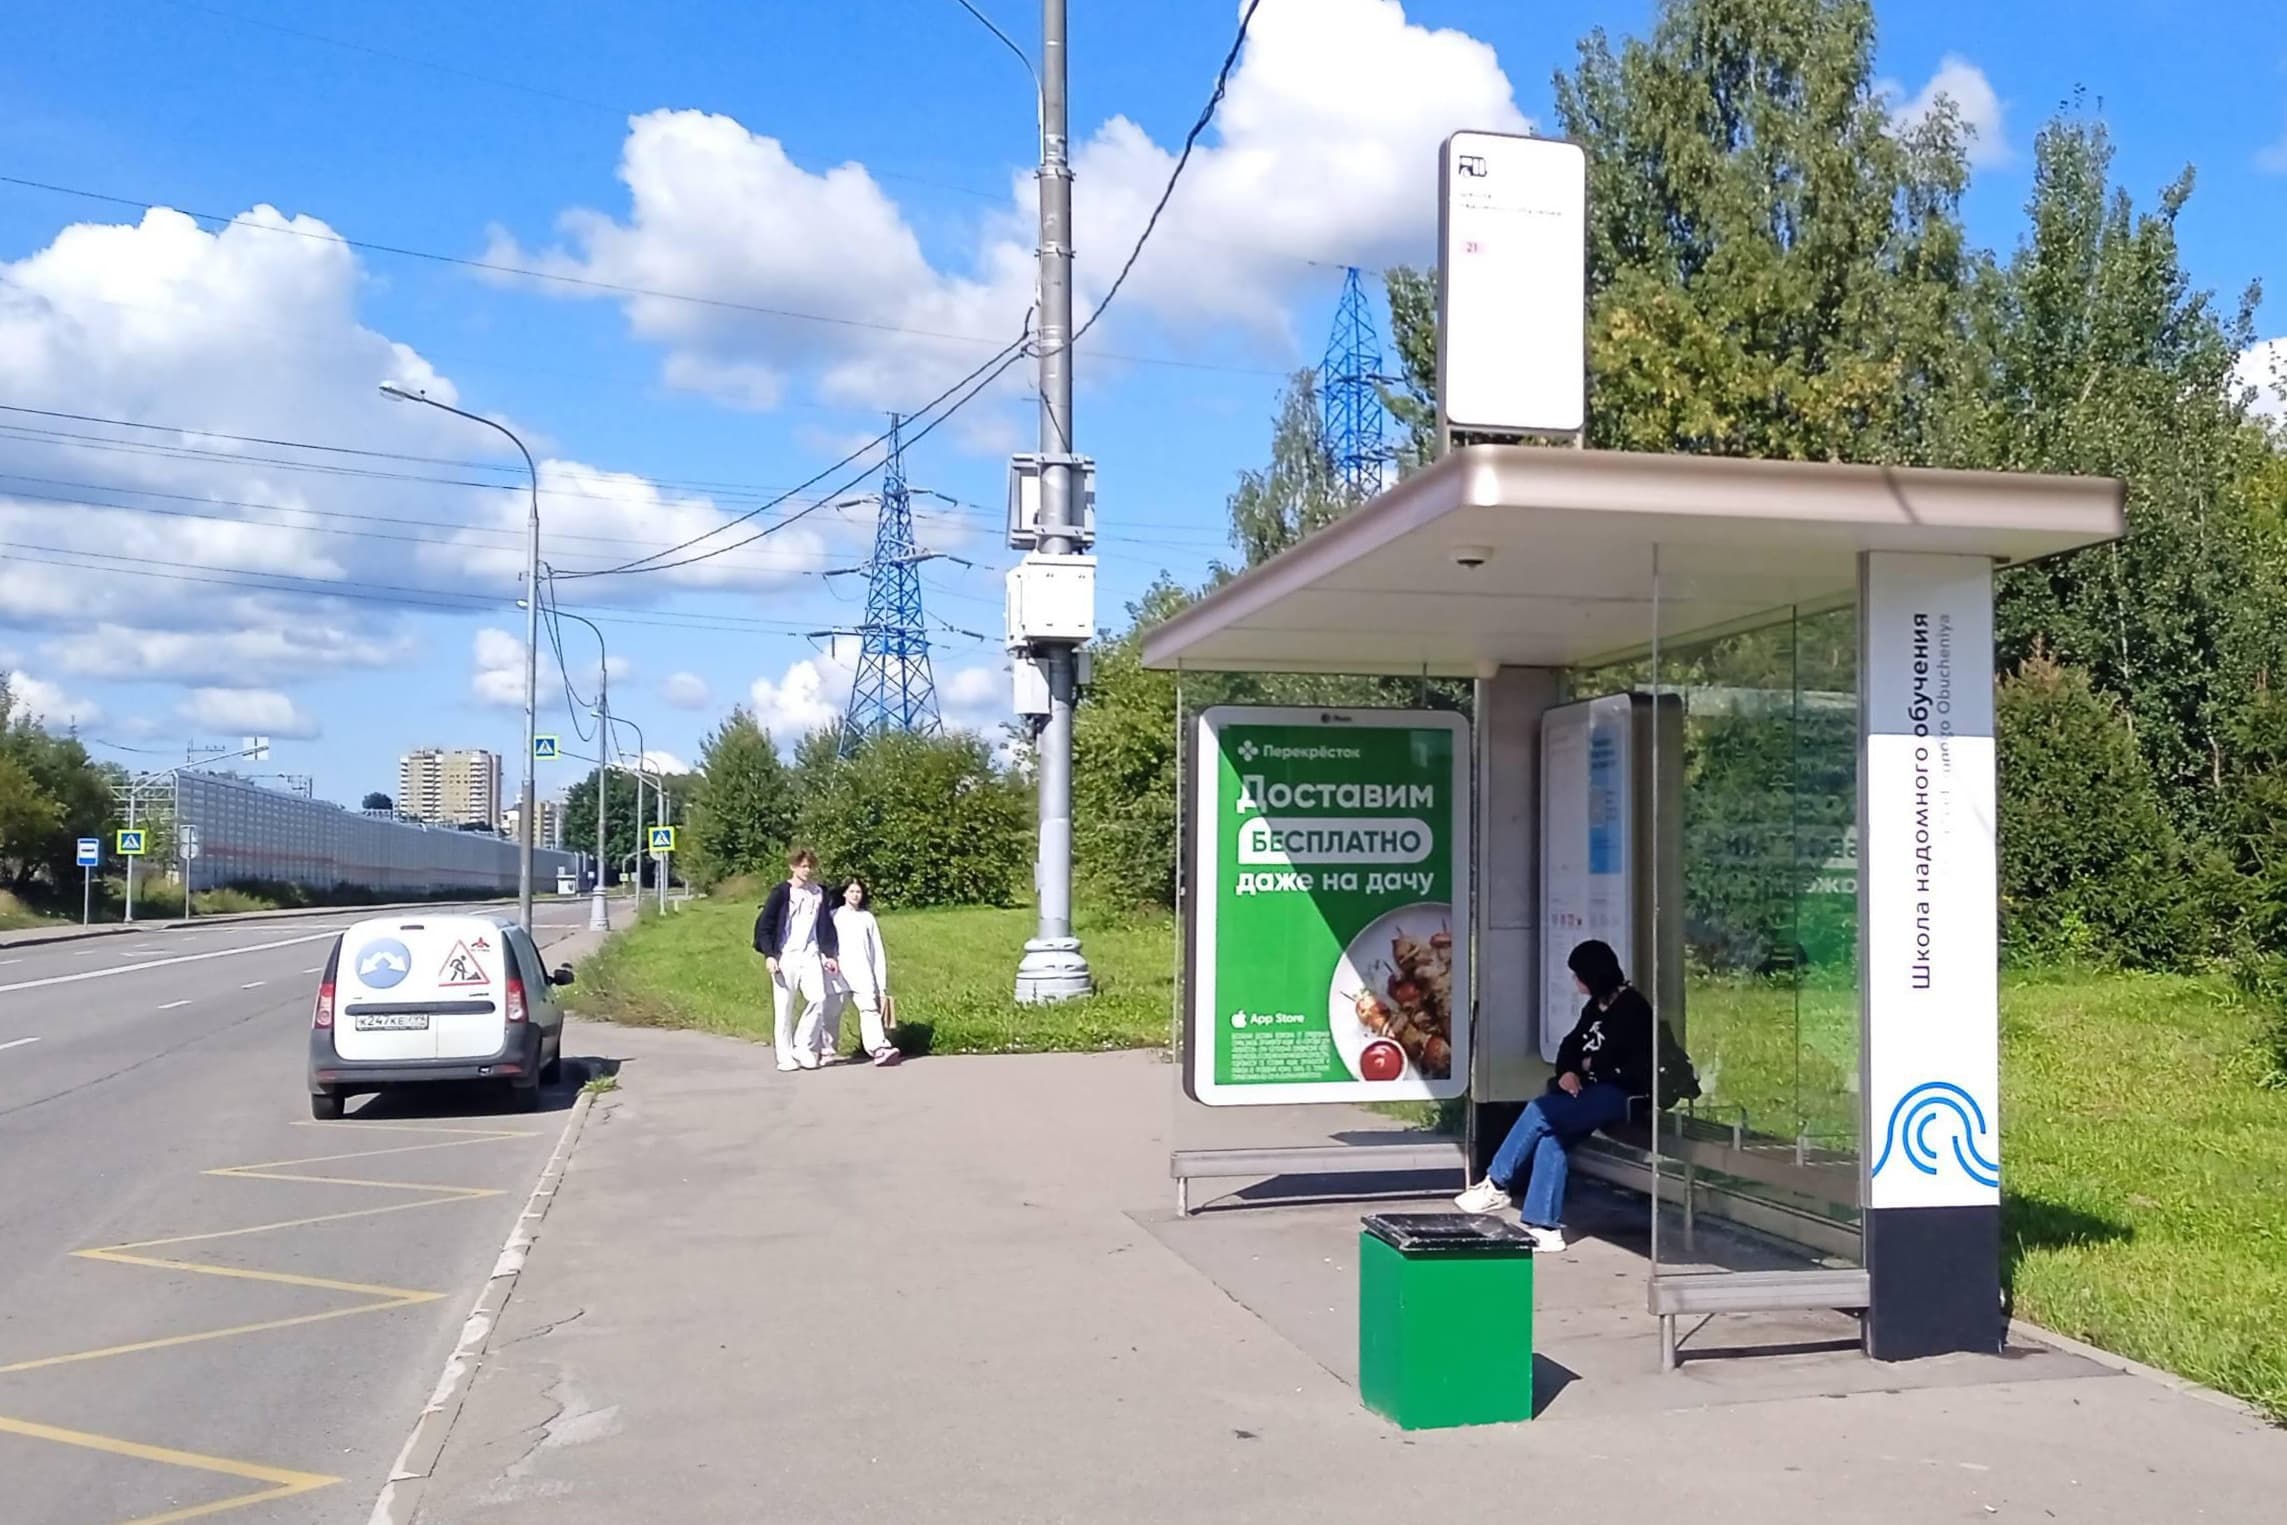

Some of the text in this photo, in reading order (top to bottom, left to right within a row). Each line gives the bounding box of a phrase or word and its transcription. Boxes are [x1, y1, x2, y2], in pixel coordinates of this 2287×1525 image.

[1936, 614, 1953, 714] Obucheniya
[1263, 744, 1361, 760] Перекрёсток
[1236, 774, 1434, 814] Доставим
[1908, 613, 1934, 989] Школа надомного обучения
[1252, 830, 1421, 853] БЕСПЛАТНО
[1236, 872, 1434, 896] даже на дачу
[1250, 1013, 1305, 1026] App Store
